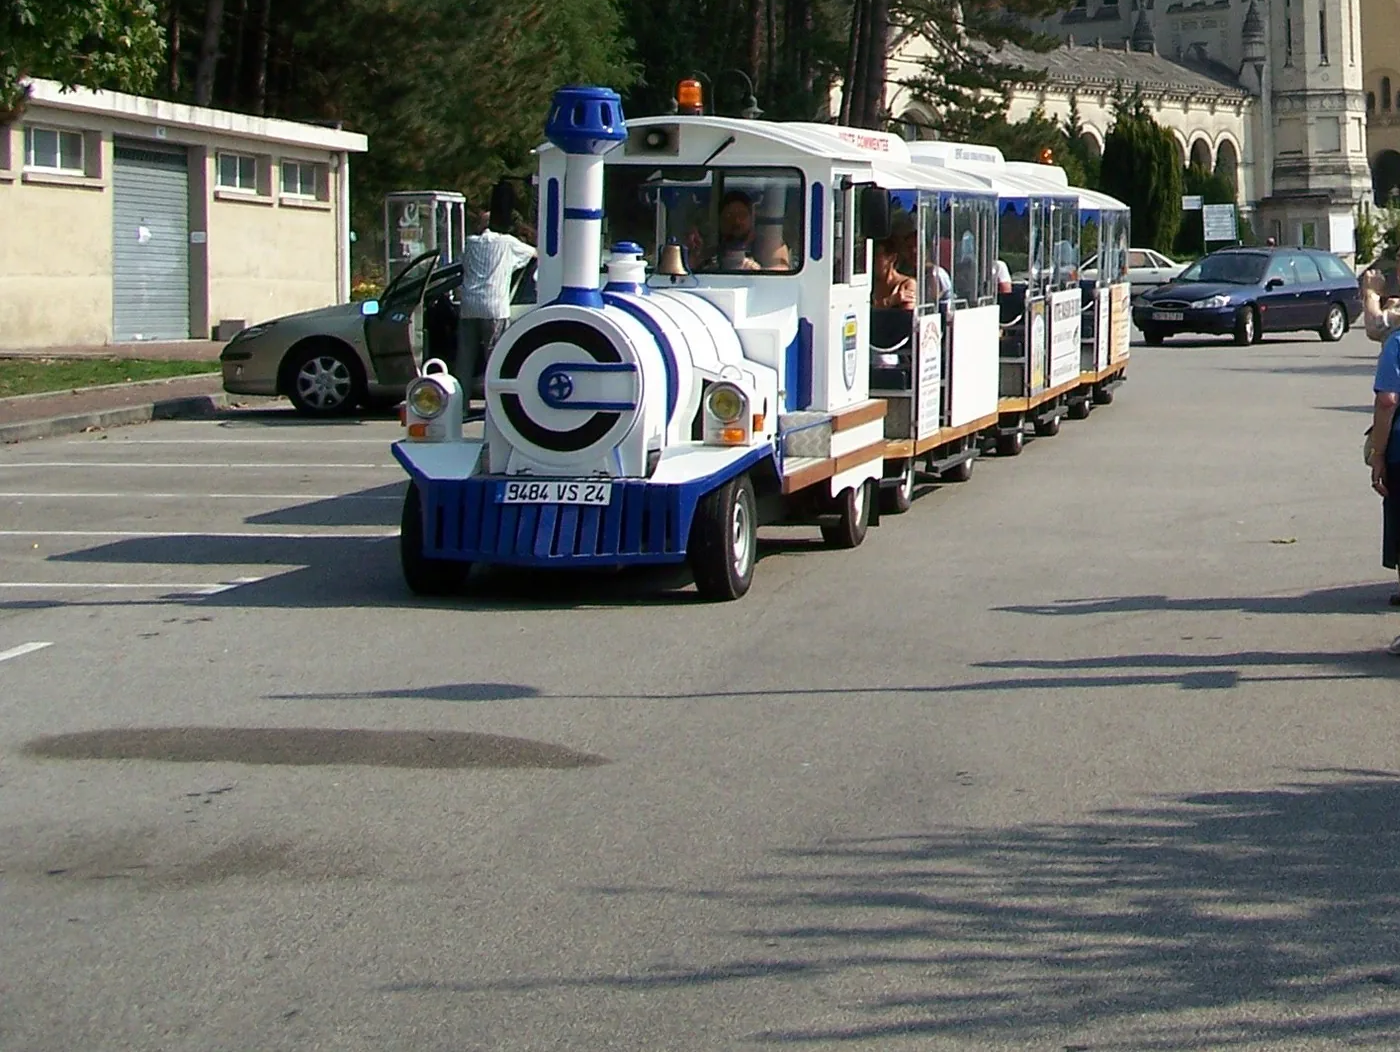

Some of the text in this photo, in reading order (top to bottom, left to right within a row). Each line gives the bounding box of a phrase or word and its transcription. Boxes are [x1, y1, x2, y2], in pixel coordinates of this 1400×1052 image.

[507, 483, 605, 502] 9484 VS 24
